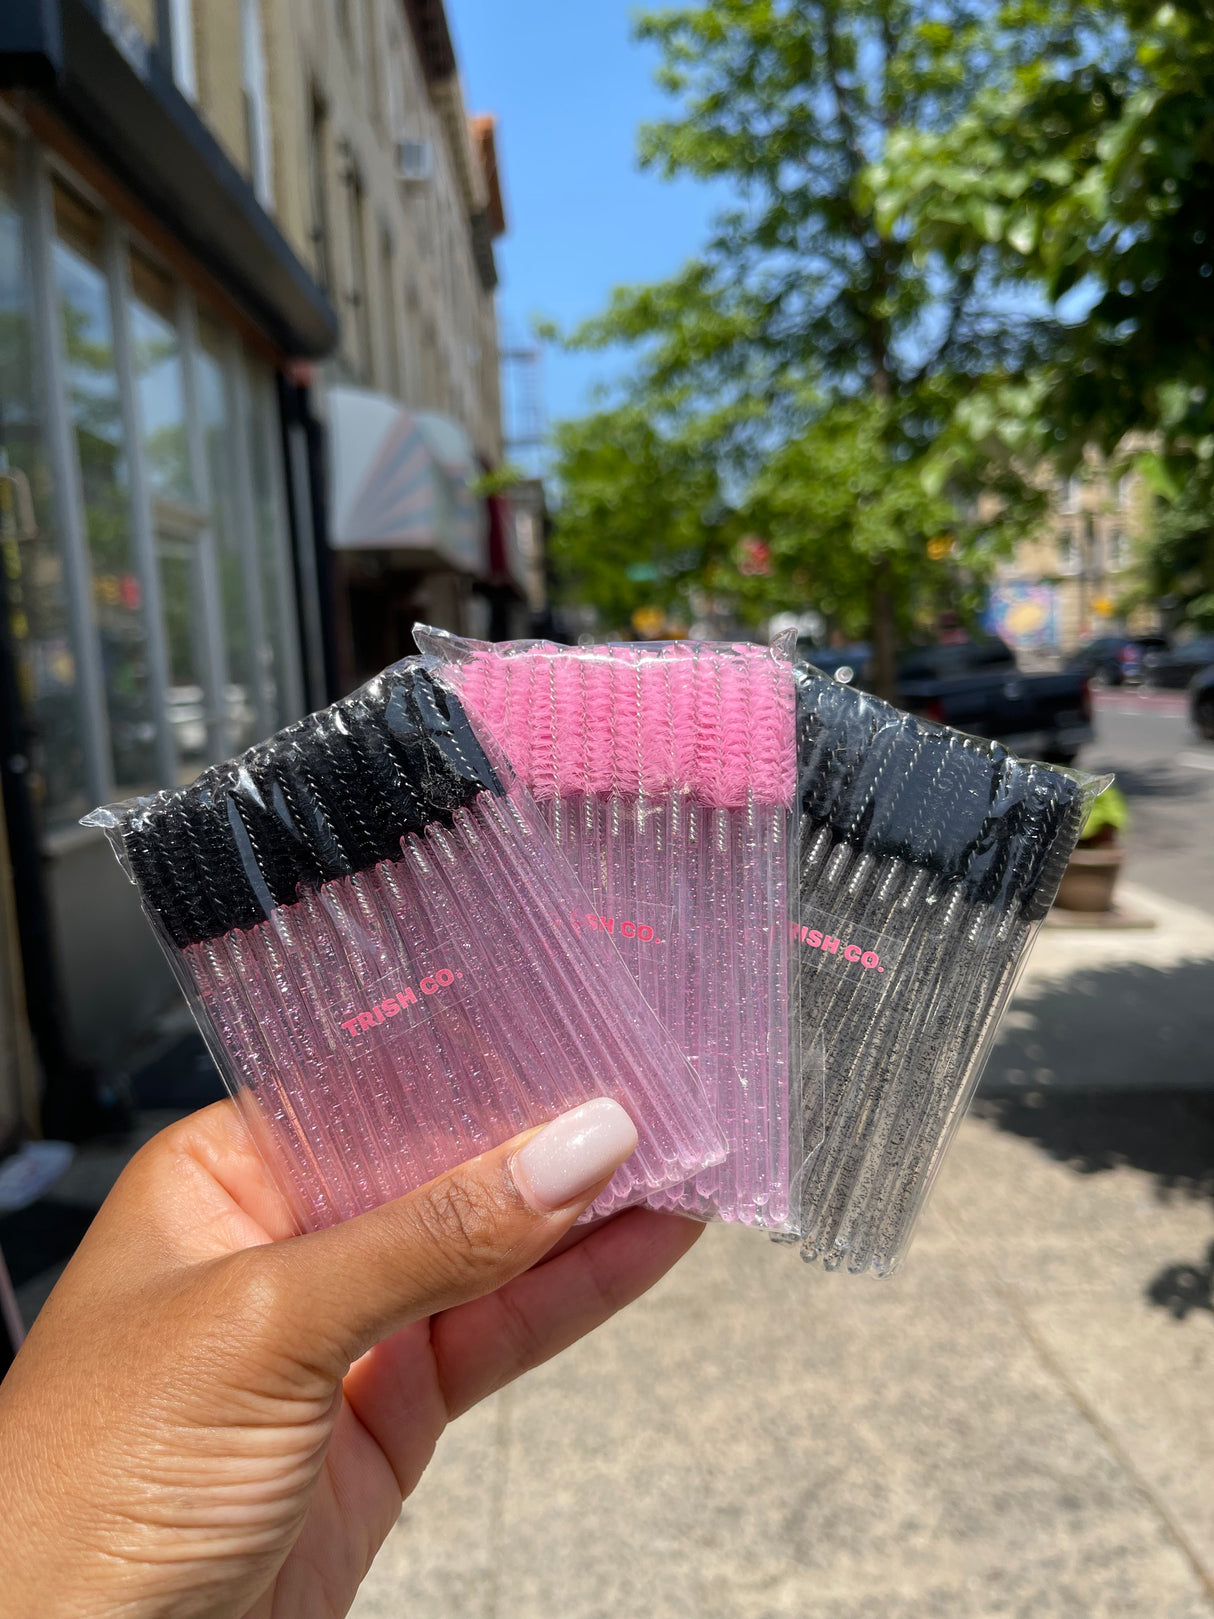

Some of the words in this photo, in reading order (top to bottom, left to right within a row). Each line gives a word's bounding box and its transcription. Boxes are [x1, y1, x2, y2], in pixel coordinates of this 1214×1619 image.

[620, 921, 660, 944] CO.
[844, 944, 884, 973] CO.
[341, 986, 418, 1037] TRISH
[420, 968, 463, 995] CO.
